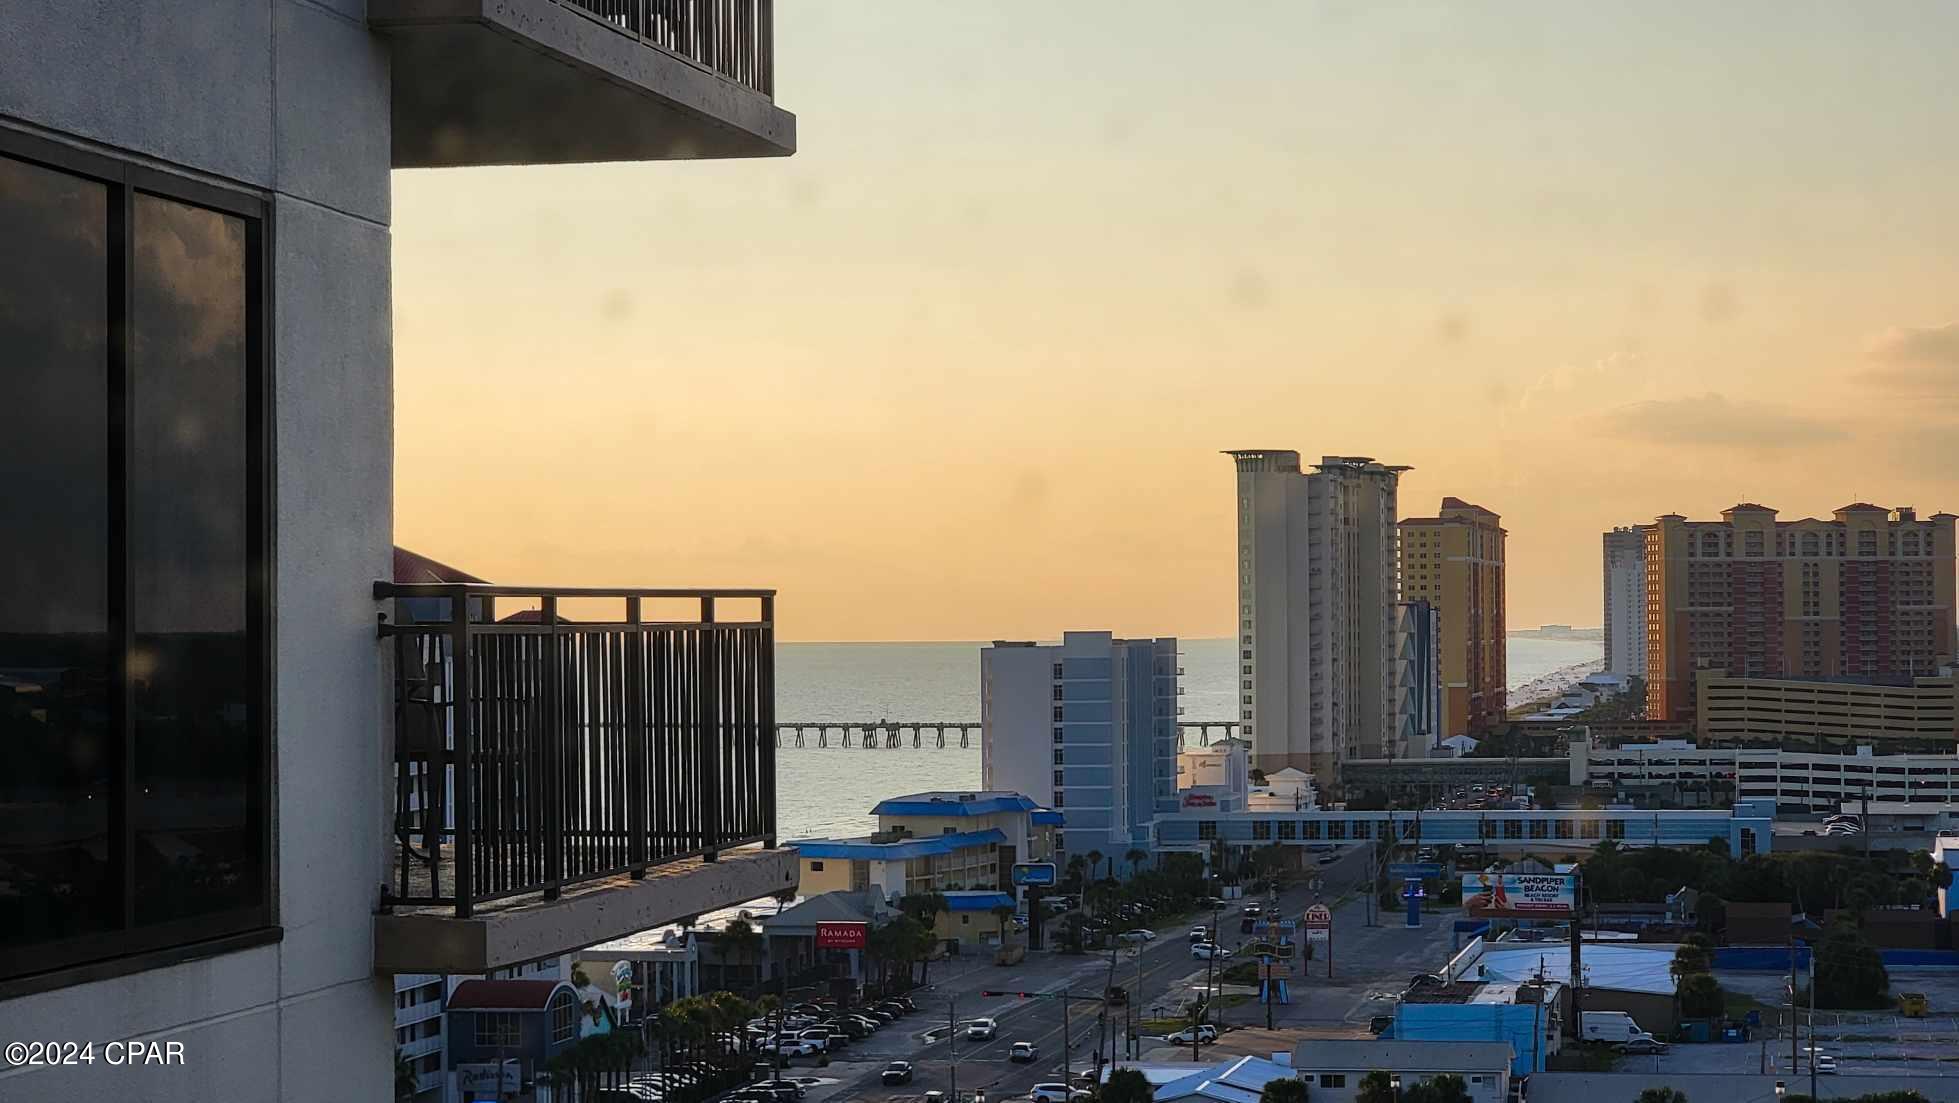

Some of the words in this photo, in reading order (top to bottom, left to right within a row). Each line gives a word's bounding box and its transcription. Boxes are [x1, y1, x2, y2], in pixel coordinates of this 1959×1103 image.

[1517, 877, 1565, 885] SANDPIPER
[1524, 885, 1559, 893] BEACON
[820, 928, 862, 937] RAMADA
